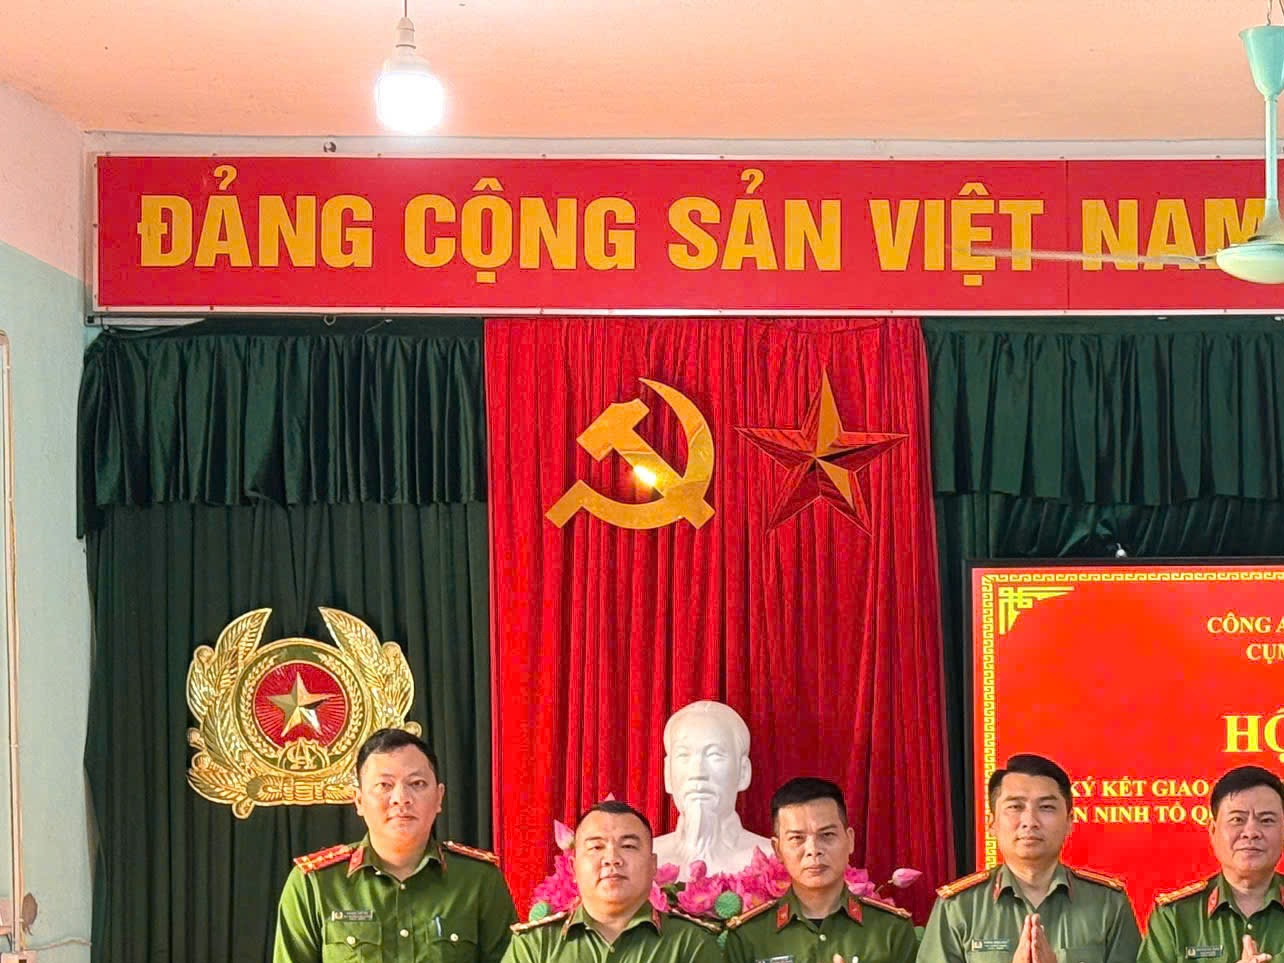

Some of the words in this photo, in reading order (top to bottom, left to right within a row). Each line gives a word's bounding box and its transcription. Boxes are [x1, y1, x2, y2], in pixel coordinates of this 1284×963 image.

[137, 165, 373, 268] ĐẢNG
[404, 177, 636, 284] CỘNG
[667, 168, 842, 272] SẢN
[869, 182, 1044, 286] VIỆT
[1207, 611, 1271, 633] CÔNG
[1102, 775, 1147, 797] KẾT
[1152, 779, 1209, 797] GIAO
[1094, 806, 1149, 823] NINH
